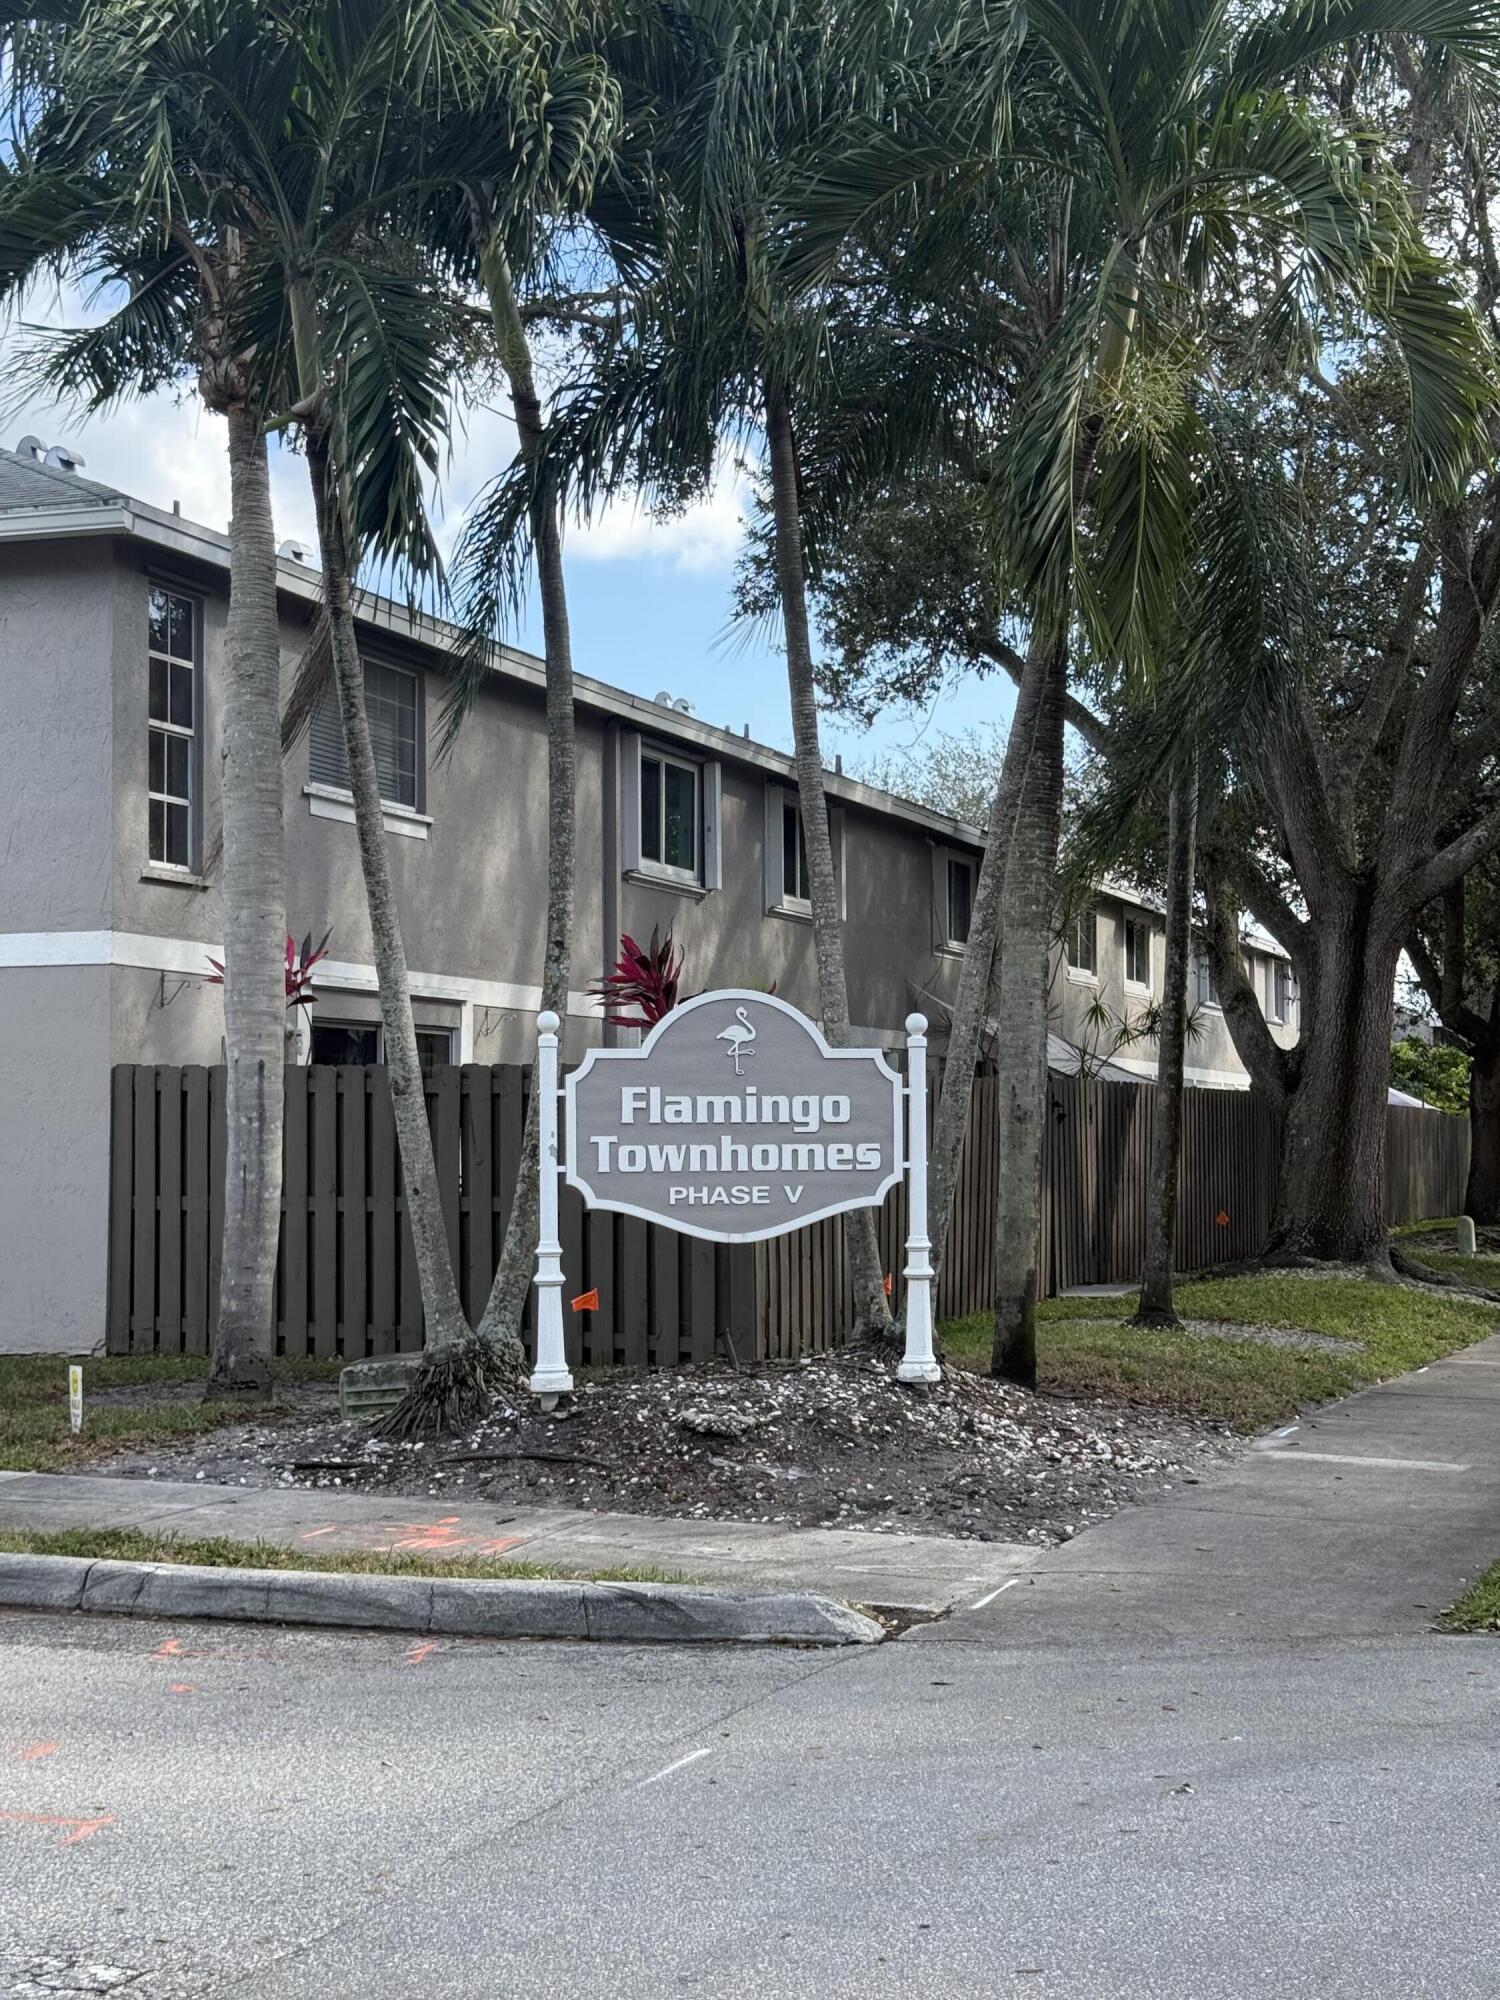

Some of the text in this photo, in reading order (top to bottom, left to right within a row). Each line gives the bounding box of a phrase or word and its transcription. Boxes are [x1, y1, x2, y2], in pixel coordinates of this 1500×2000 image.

[621, 1086, 851, 1133] Flamingo
[590, 1135, 881, 1173] Townhomes
[669, 1185, 804, 1205] PHASE V
